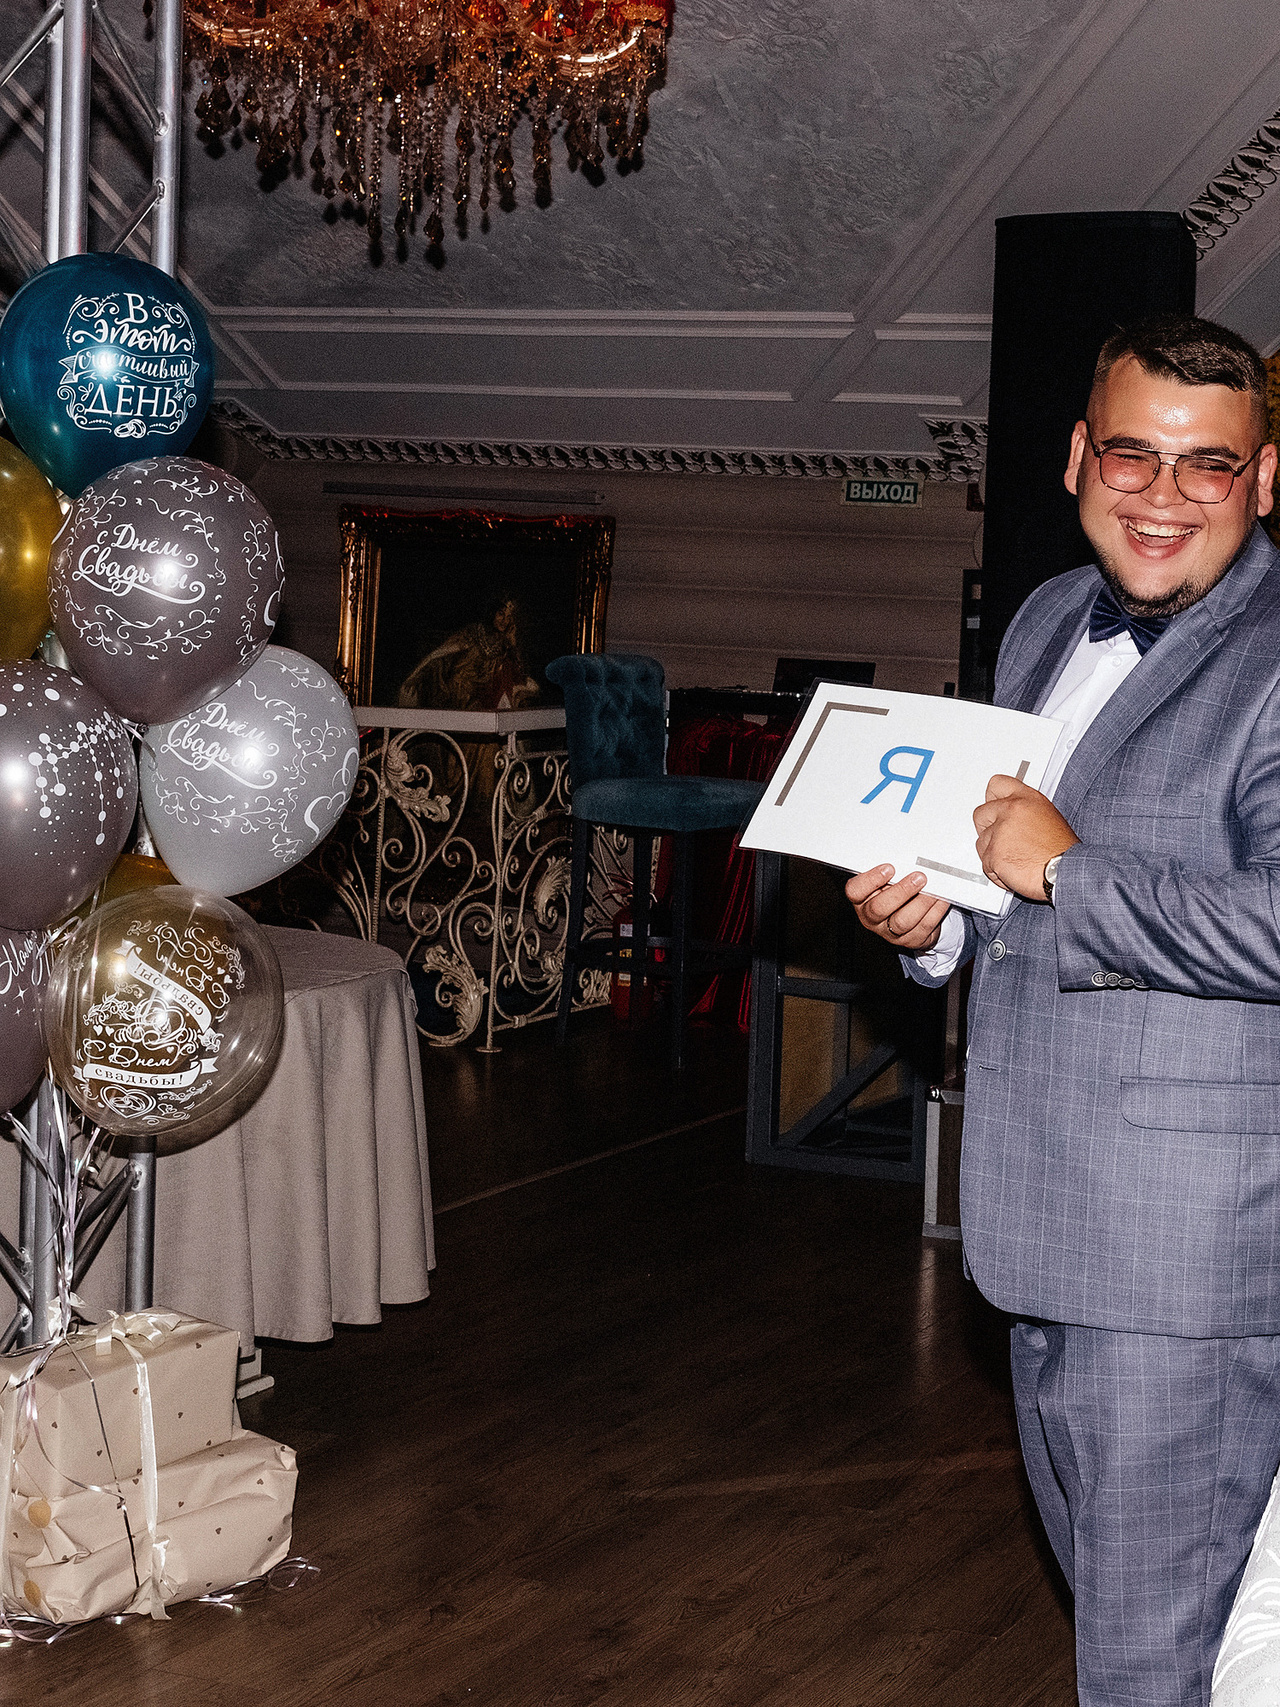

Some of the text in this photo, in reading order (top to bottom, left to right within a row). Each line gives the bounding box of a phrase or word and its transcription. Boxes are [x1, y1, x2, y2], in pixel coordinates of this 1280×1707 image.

[114, 292, 149, 324] В
[78, 351, 190, 379] счтливый
[84, 384, 177, 417] ДЕНЬ
[849, 482, 915, 503] ВЫХОД
[860, 745, 936, 814] Я
[94, 1066, 183, 1086] свадьбы!
